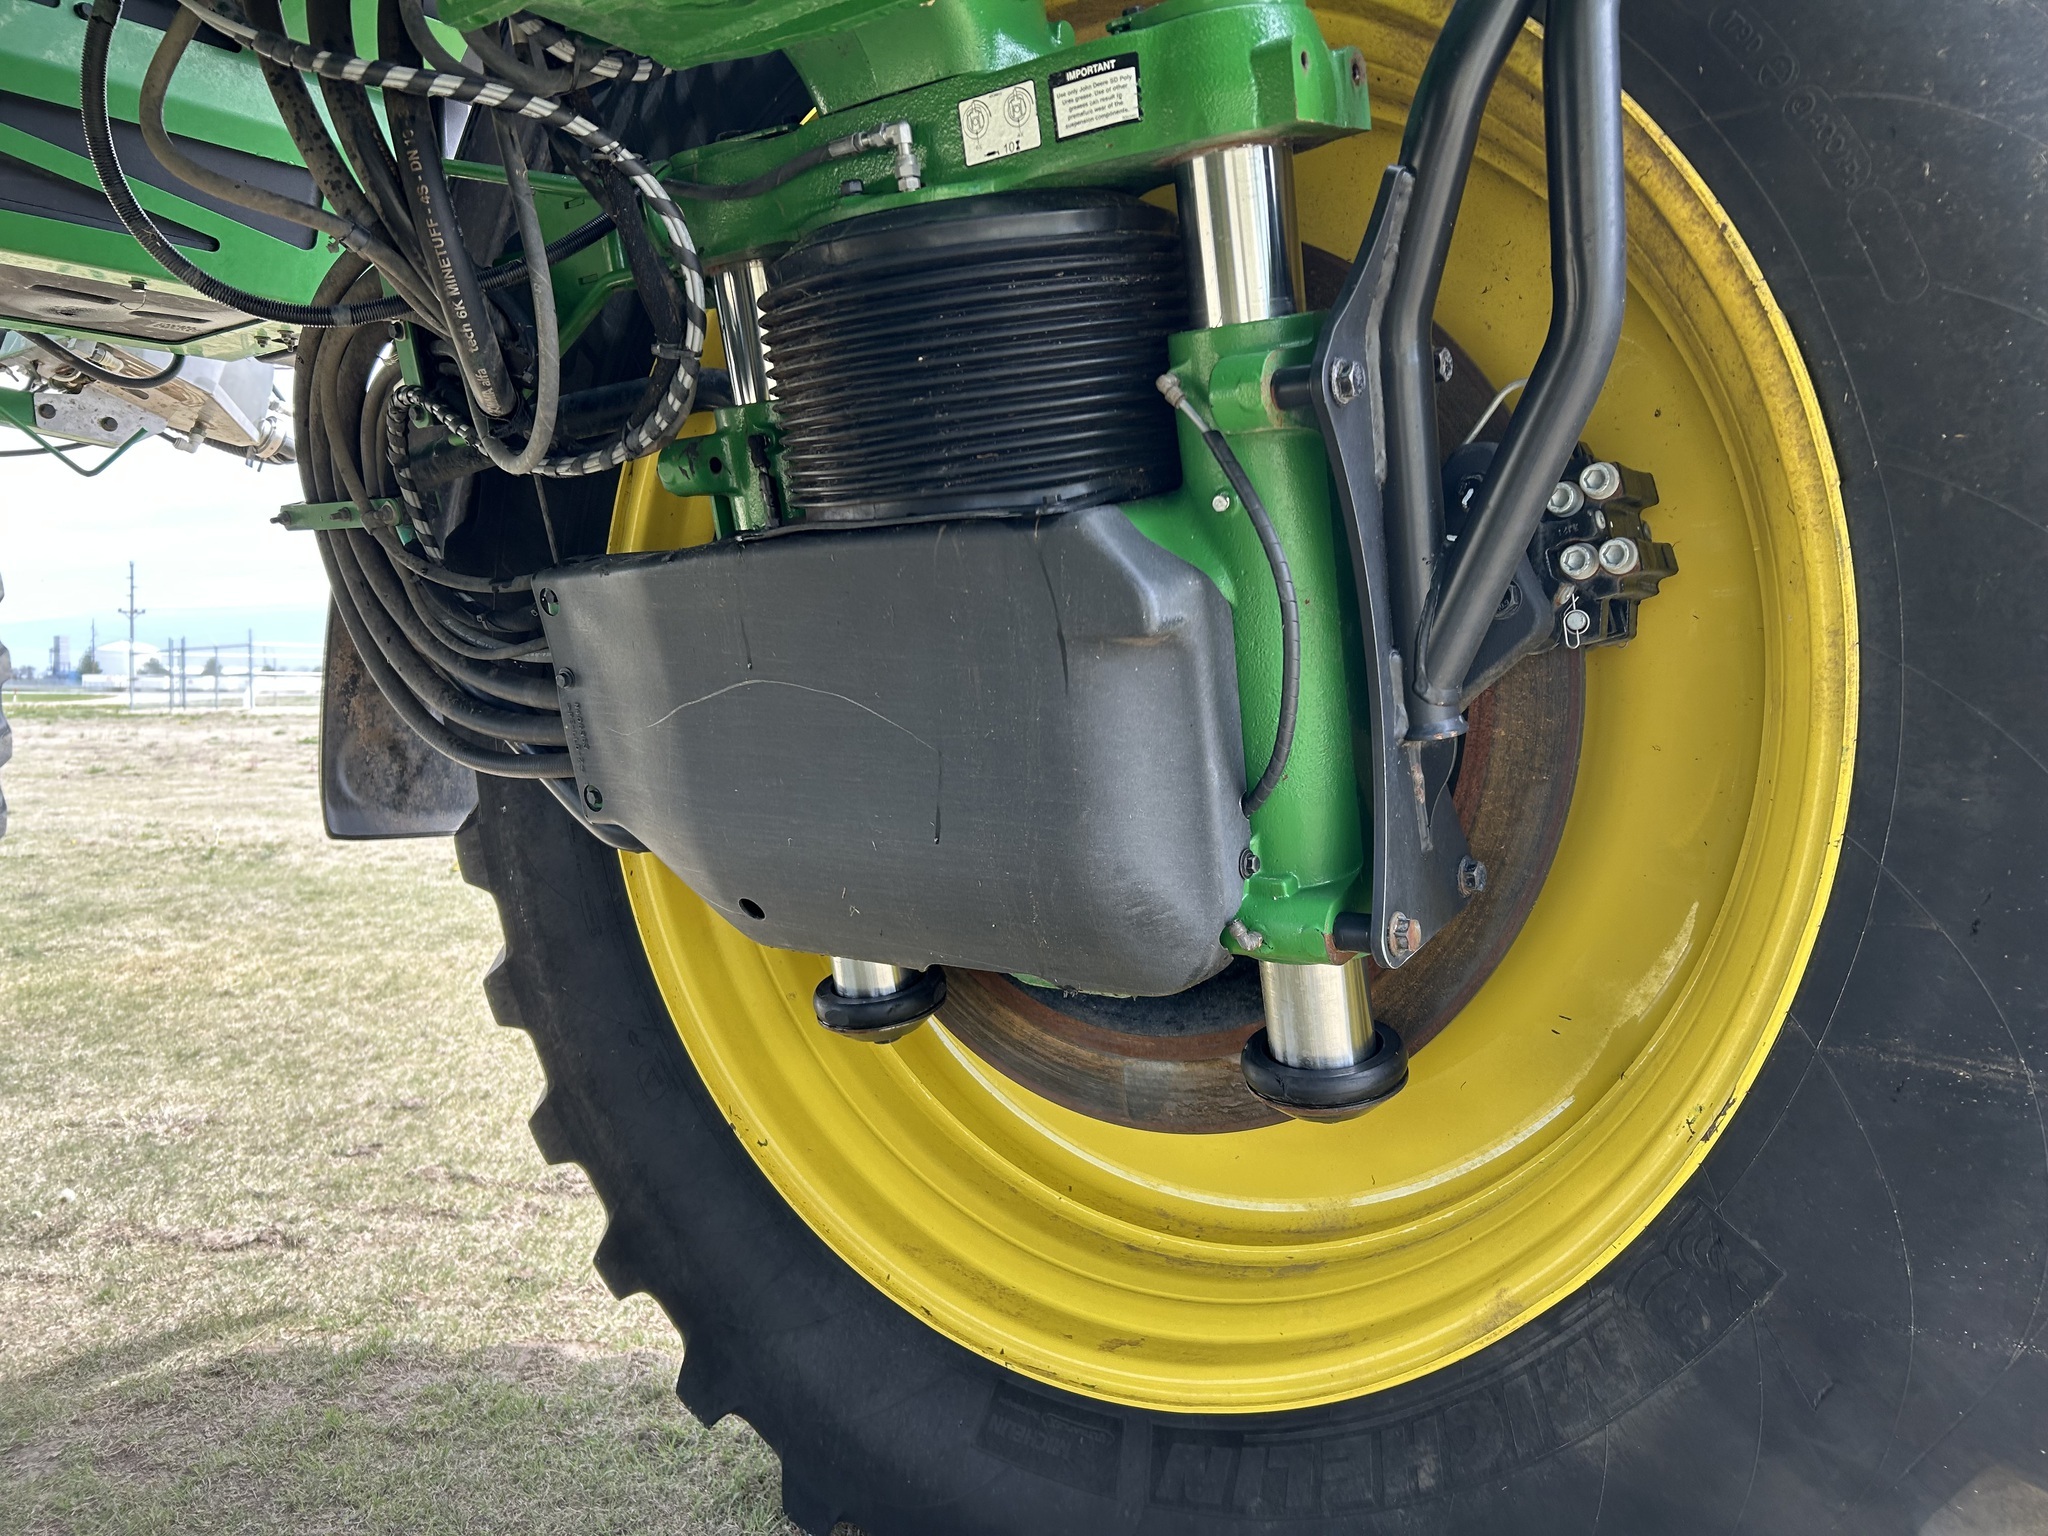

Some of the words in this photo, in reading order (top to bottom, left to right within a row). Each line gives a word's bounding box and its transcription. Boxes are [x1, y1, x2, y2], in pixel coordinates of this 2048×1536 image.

[1066, 59, 1117, 81] IMPORTANT
[1067, 88, 1078, 97] only
[1079, 85, 1092, 93] John
[1092, 80, 1109, 88] Deere
[1119, 74, 1132, 82] Poly
[1112, 83, 1128, 91] other
[1100, 94, 1116, 102] result
[1065, 117, 1094, 129] suspension
[407, 150, 422, 171] DN
[419, 184, 430, 206] 4S
[426, 218, 460, 297] MINETUFF
[452, 299, 468, 319] 6K
[462, 323, 479, 353] tech
[475, 368, 491, 387] alfa
[1154, 1312, 1640, 1512] MICHELIN
